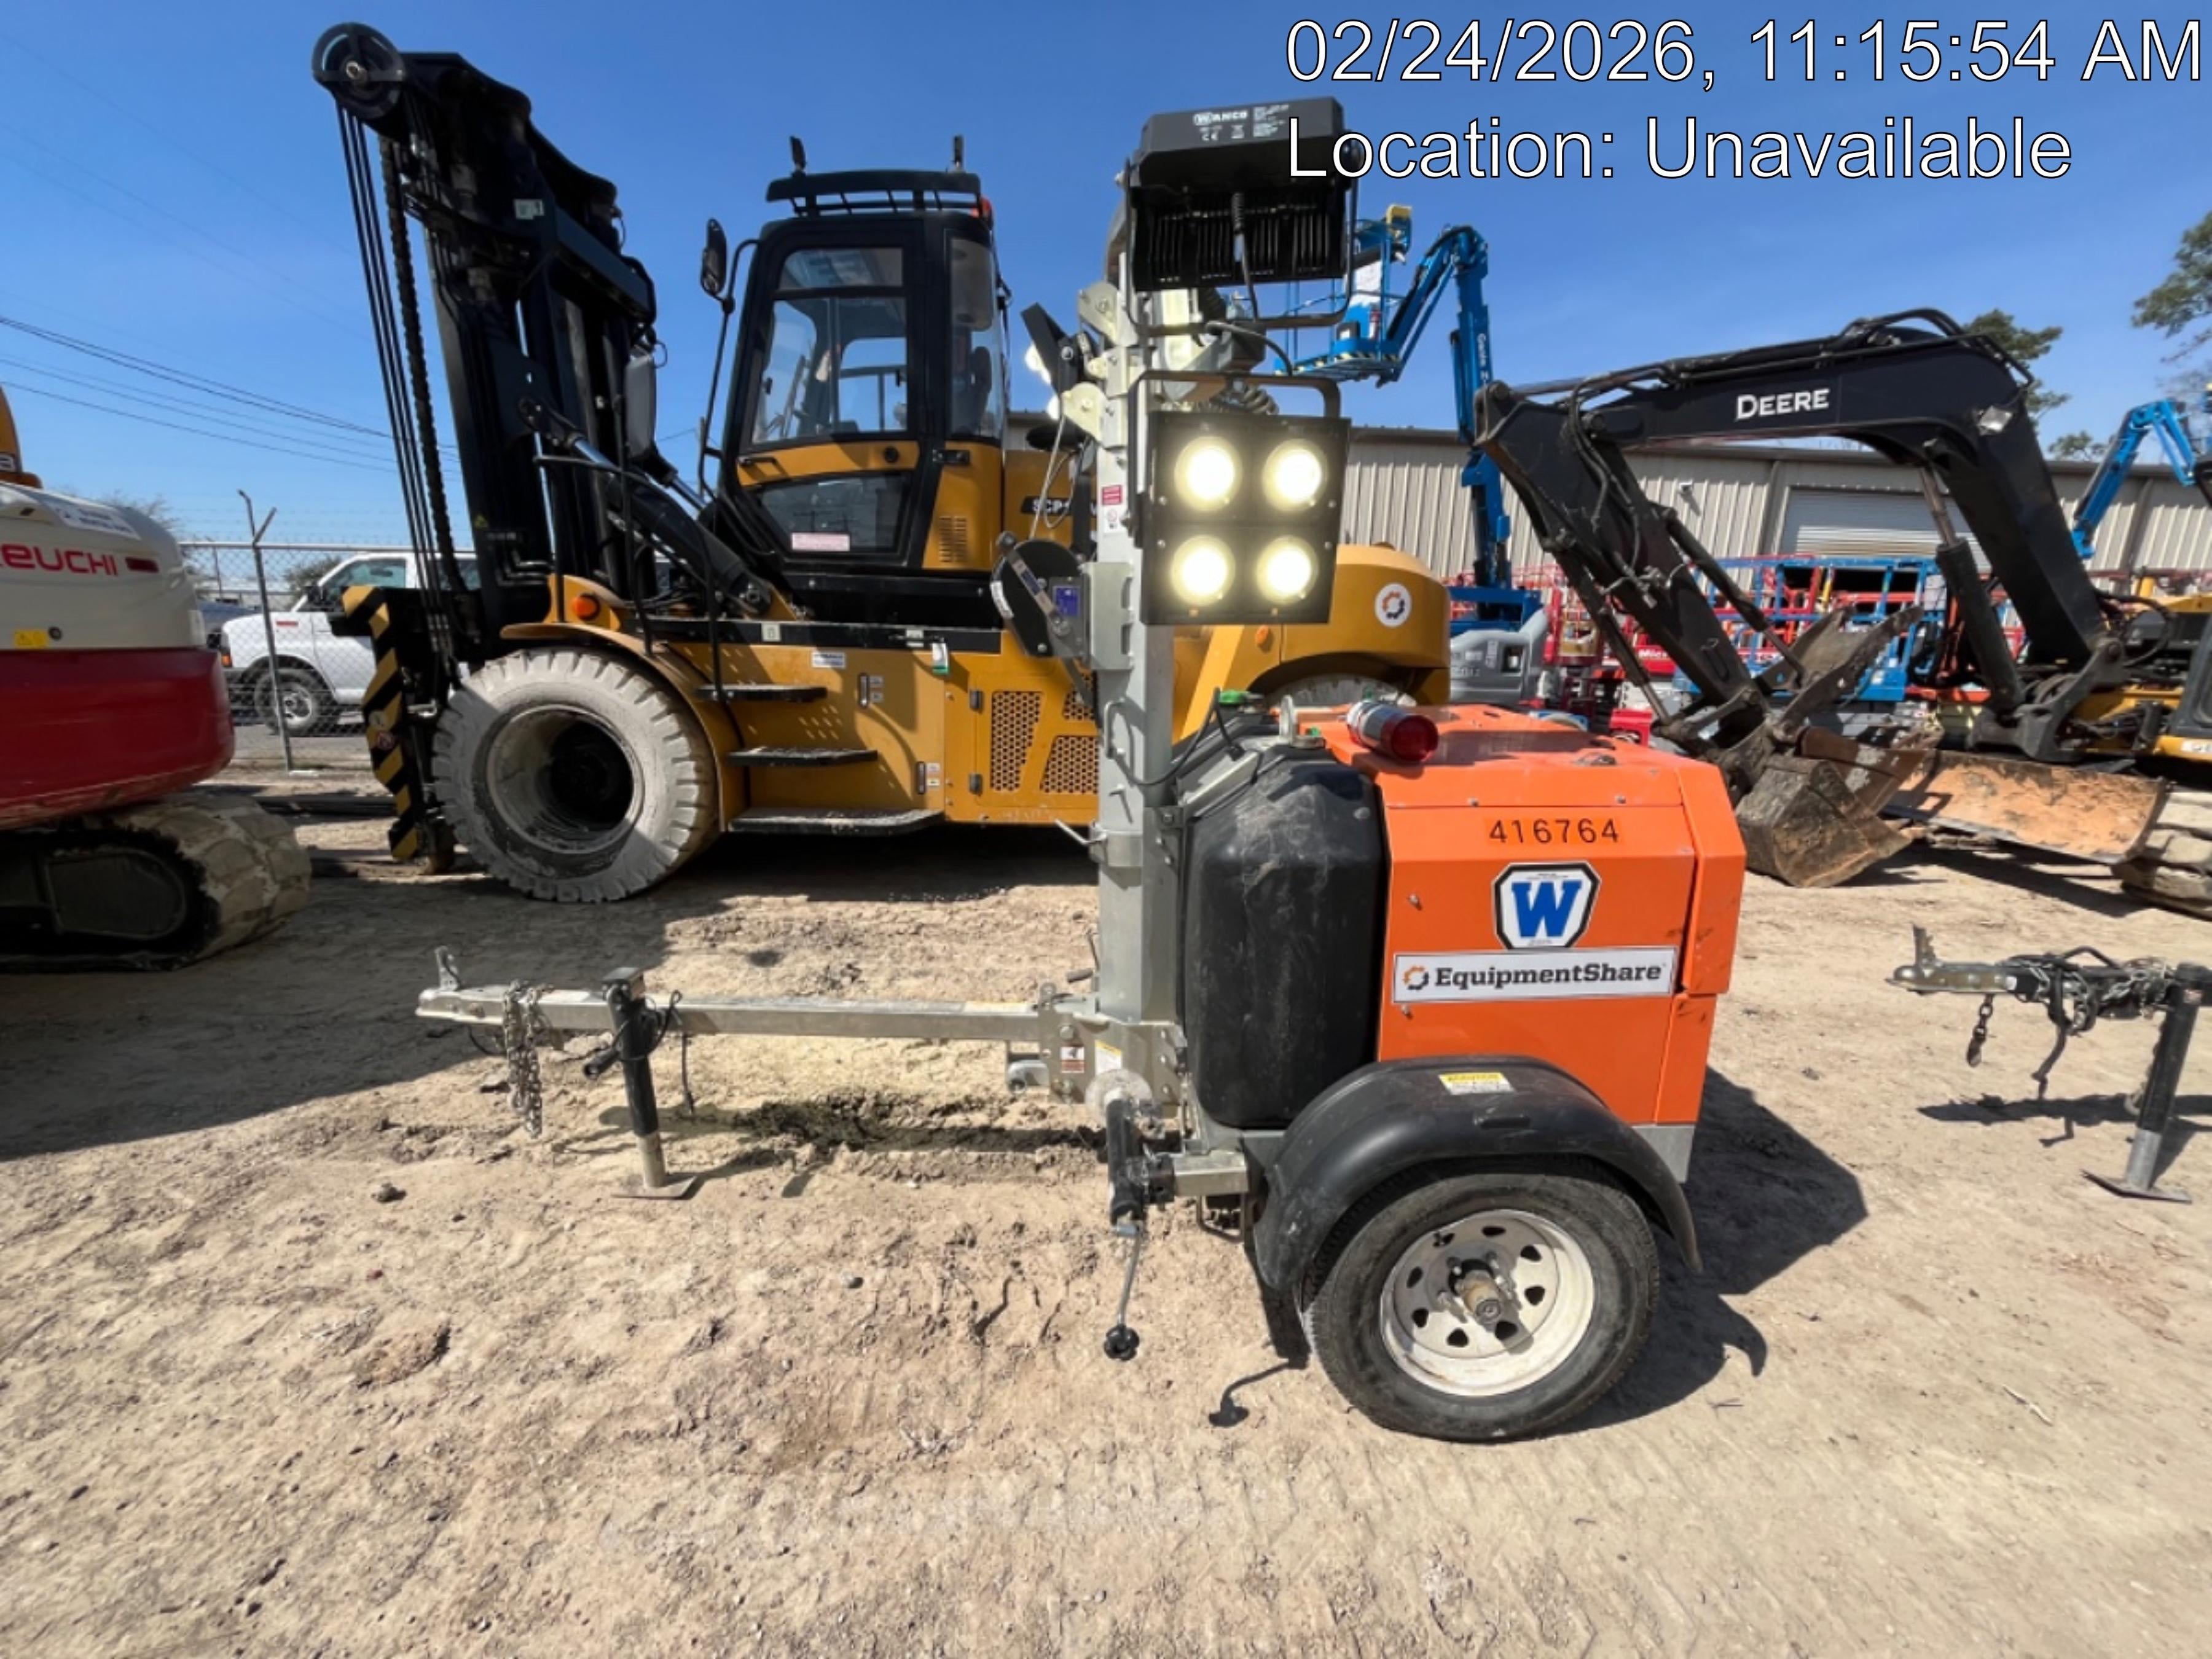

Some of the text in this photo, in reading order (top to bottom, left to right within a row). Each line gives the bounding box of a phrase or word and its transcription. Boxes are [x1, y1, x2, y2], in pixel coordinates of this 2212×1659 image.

[1736, 388, 1830, 420] DEERE
[1489, 819, 1618, 844] 416764
[1435, 963, 1662, 990] EquipmentShare
